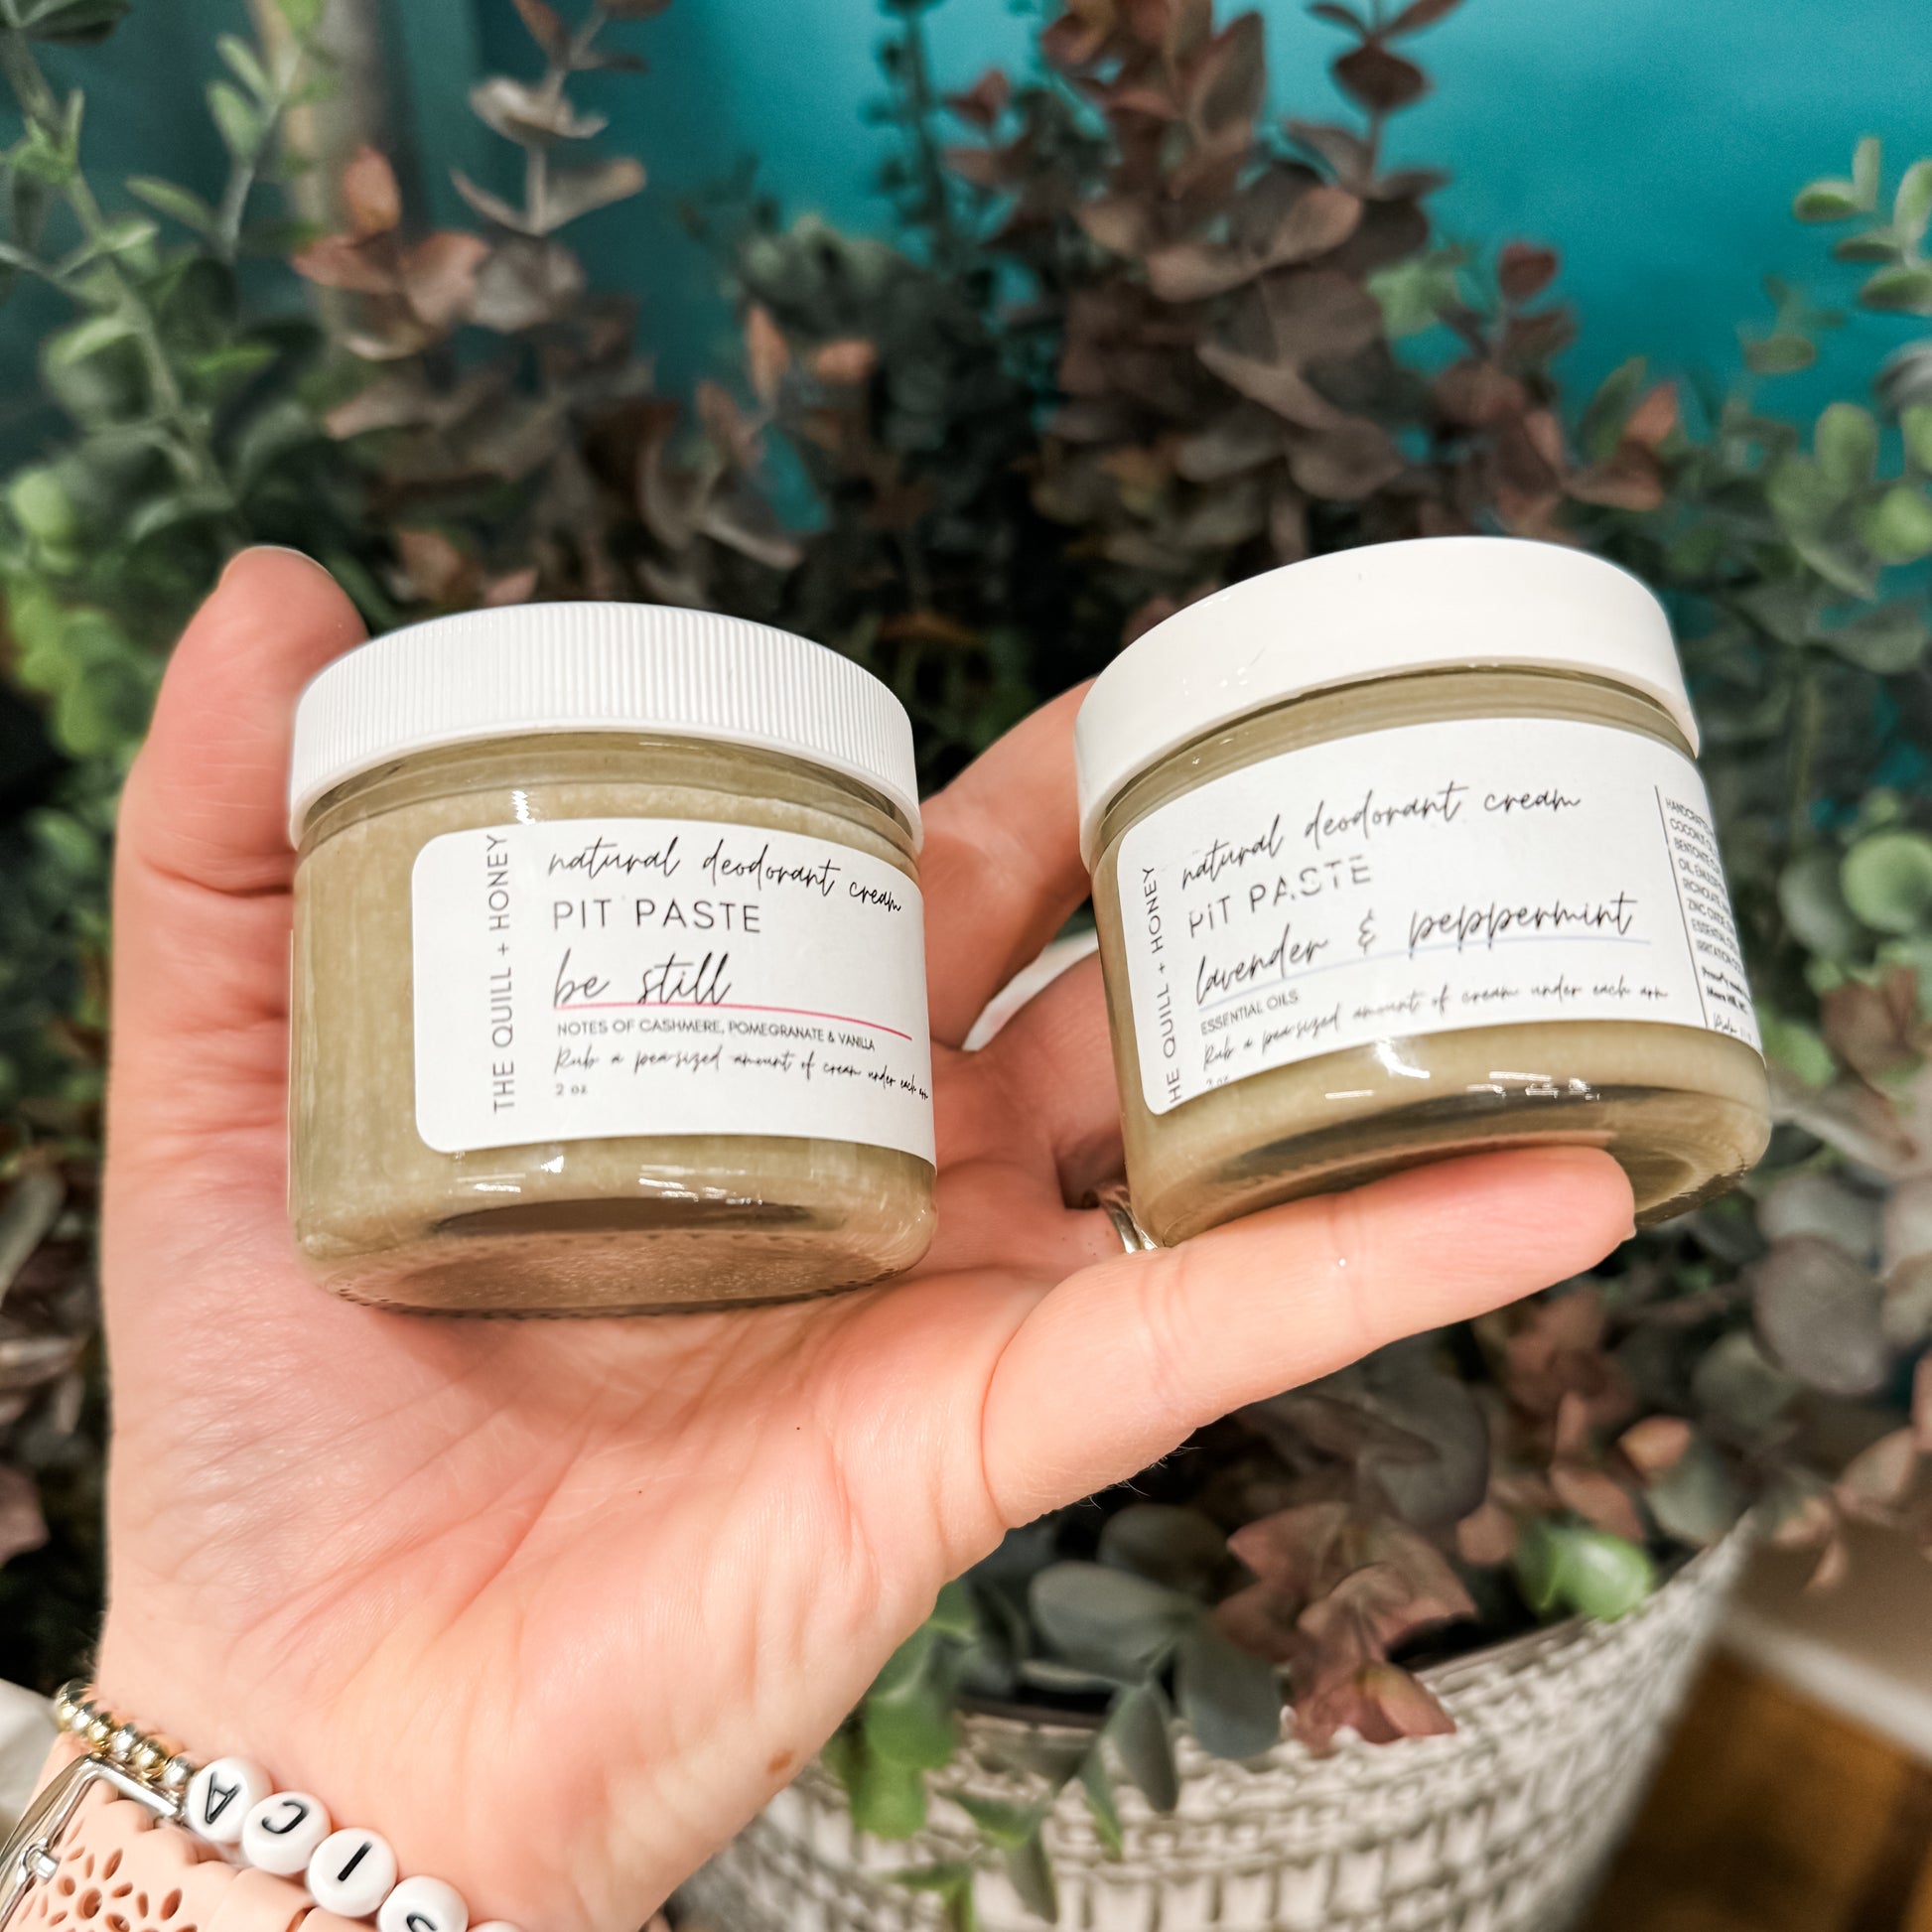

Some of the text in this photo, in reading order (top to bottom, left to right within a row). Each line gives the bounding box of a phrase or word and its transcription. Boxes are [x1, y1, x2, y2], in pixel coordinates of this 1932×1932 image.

[1181, 781, 1583, 891] natural deodorant cream
[486, 834, 510, 931] HONEY
[548, 835, 902, 912] natural deodorant cream
[1250, 854, 1371, 912] PASTE
[553, 897, 761, 934] PIT PASTE
[1142, 866, 1165, 954] HONEY
[554, 947, 733, 1007] be still
[1194, 922, 1328, 1005] lavender
[1407, 891, 1638, 960] peppermint
[490, 967, 513, 1048] QUILL
[557, 1022, 609, 1036] NOTES
[612, 1020, 636, 1035] OF
[638, 1020, 726, 1035] CASHMERE,
[728, 1021, 825, 1042] POMEGRANATE
[838, 1031, 876, 1052] VANILLA
[1157, 982, 1177, 1059] QUILL
[1199, 989, 1300, 1035] ESSENTIAL OILS
[1202, 1035, 1236, 1072] Rub
[1352, 990, 1421, 1021] amount
[1431, 983, 1449, 1017] of
[1460, 986, 1520, 1005] cream
[1531, 973, 1583, 1003] under
[1591, 973, 1630, 999] each
[493, 1058, 516, 1114] THE
[554, 1041, 598, 1075] Rub
[730, 1048, 796, 1073] amount
[800, 1050, 815, 1081] of
[823, 1061, 862, 1077] cream
[868, 1064, 897, 1089] under
[554, 1082, 565, 1096] 2
